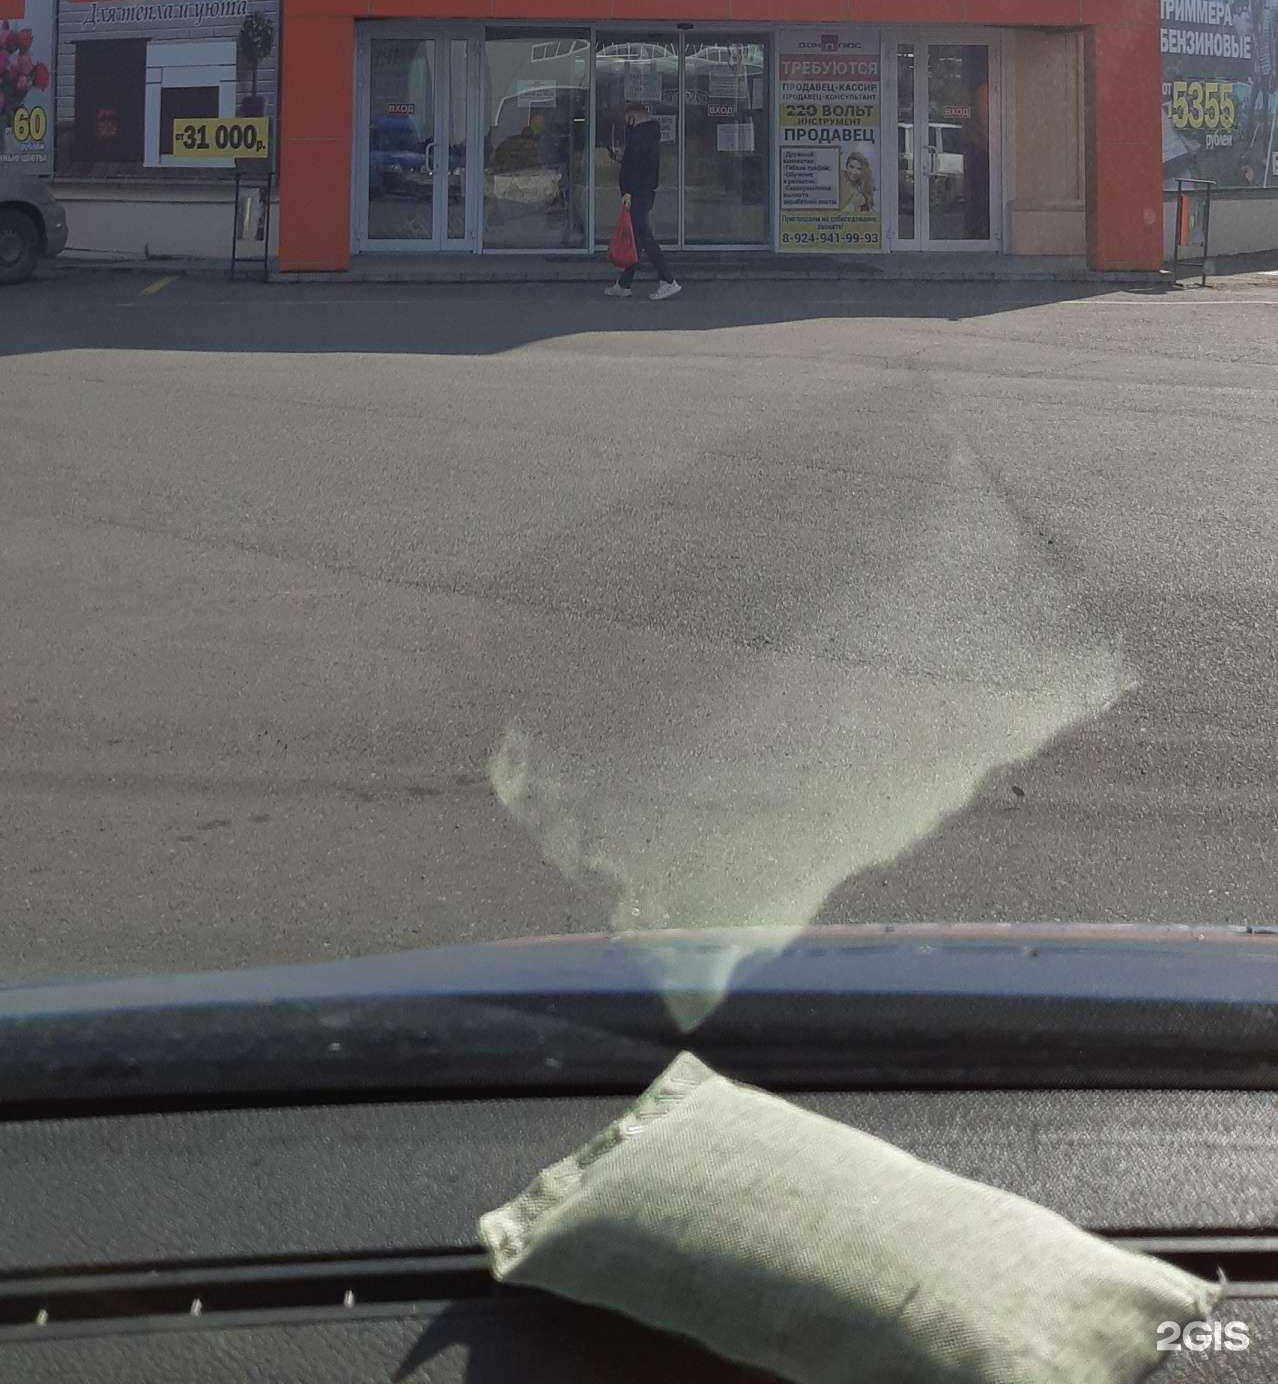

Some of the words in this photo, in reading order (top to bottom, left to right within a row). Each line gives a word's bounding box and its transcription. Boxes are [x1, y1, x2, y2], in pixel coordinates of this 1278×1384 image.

[194, 0, 248, 25] уюта
[1160, 28, 1251, 59] БЕНЗИНОВЫЕ
[782, 61, 878, 75] ТРЕБУЮТСЯ
[822, 104, 874, 117] ВОЛЬТ
[1173, 81, 1234, 129] 5355
[14, 106, 47, 142] 60
[183, 124, 210, 149] 31
[784, 128, 876, 145] ПРОДАВЕЦ
[782, 232, 879, 243] 8-924-941-99-93
